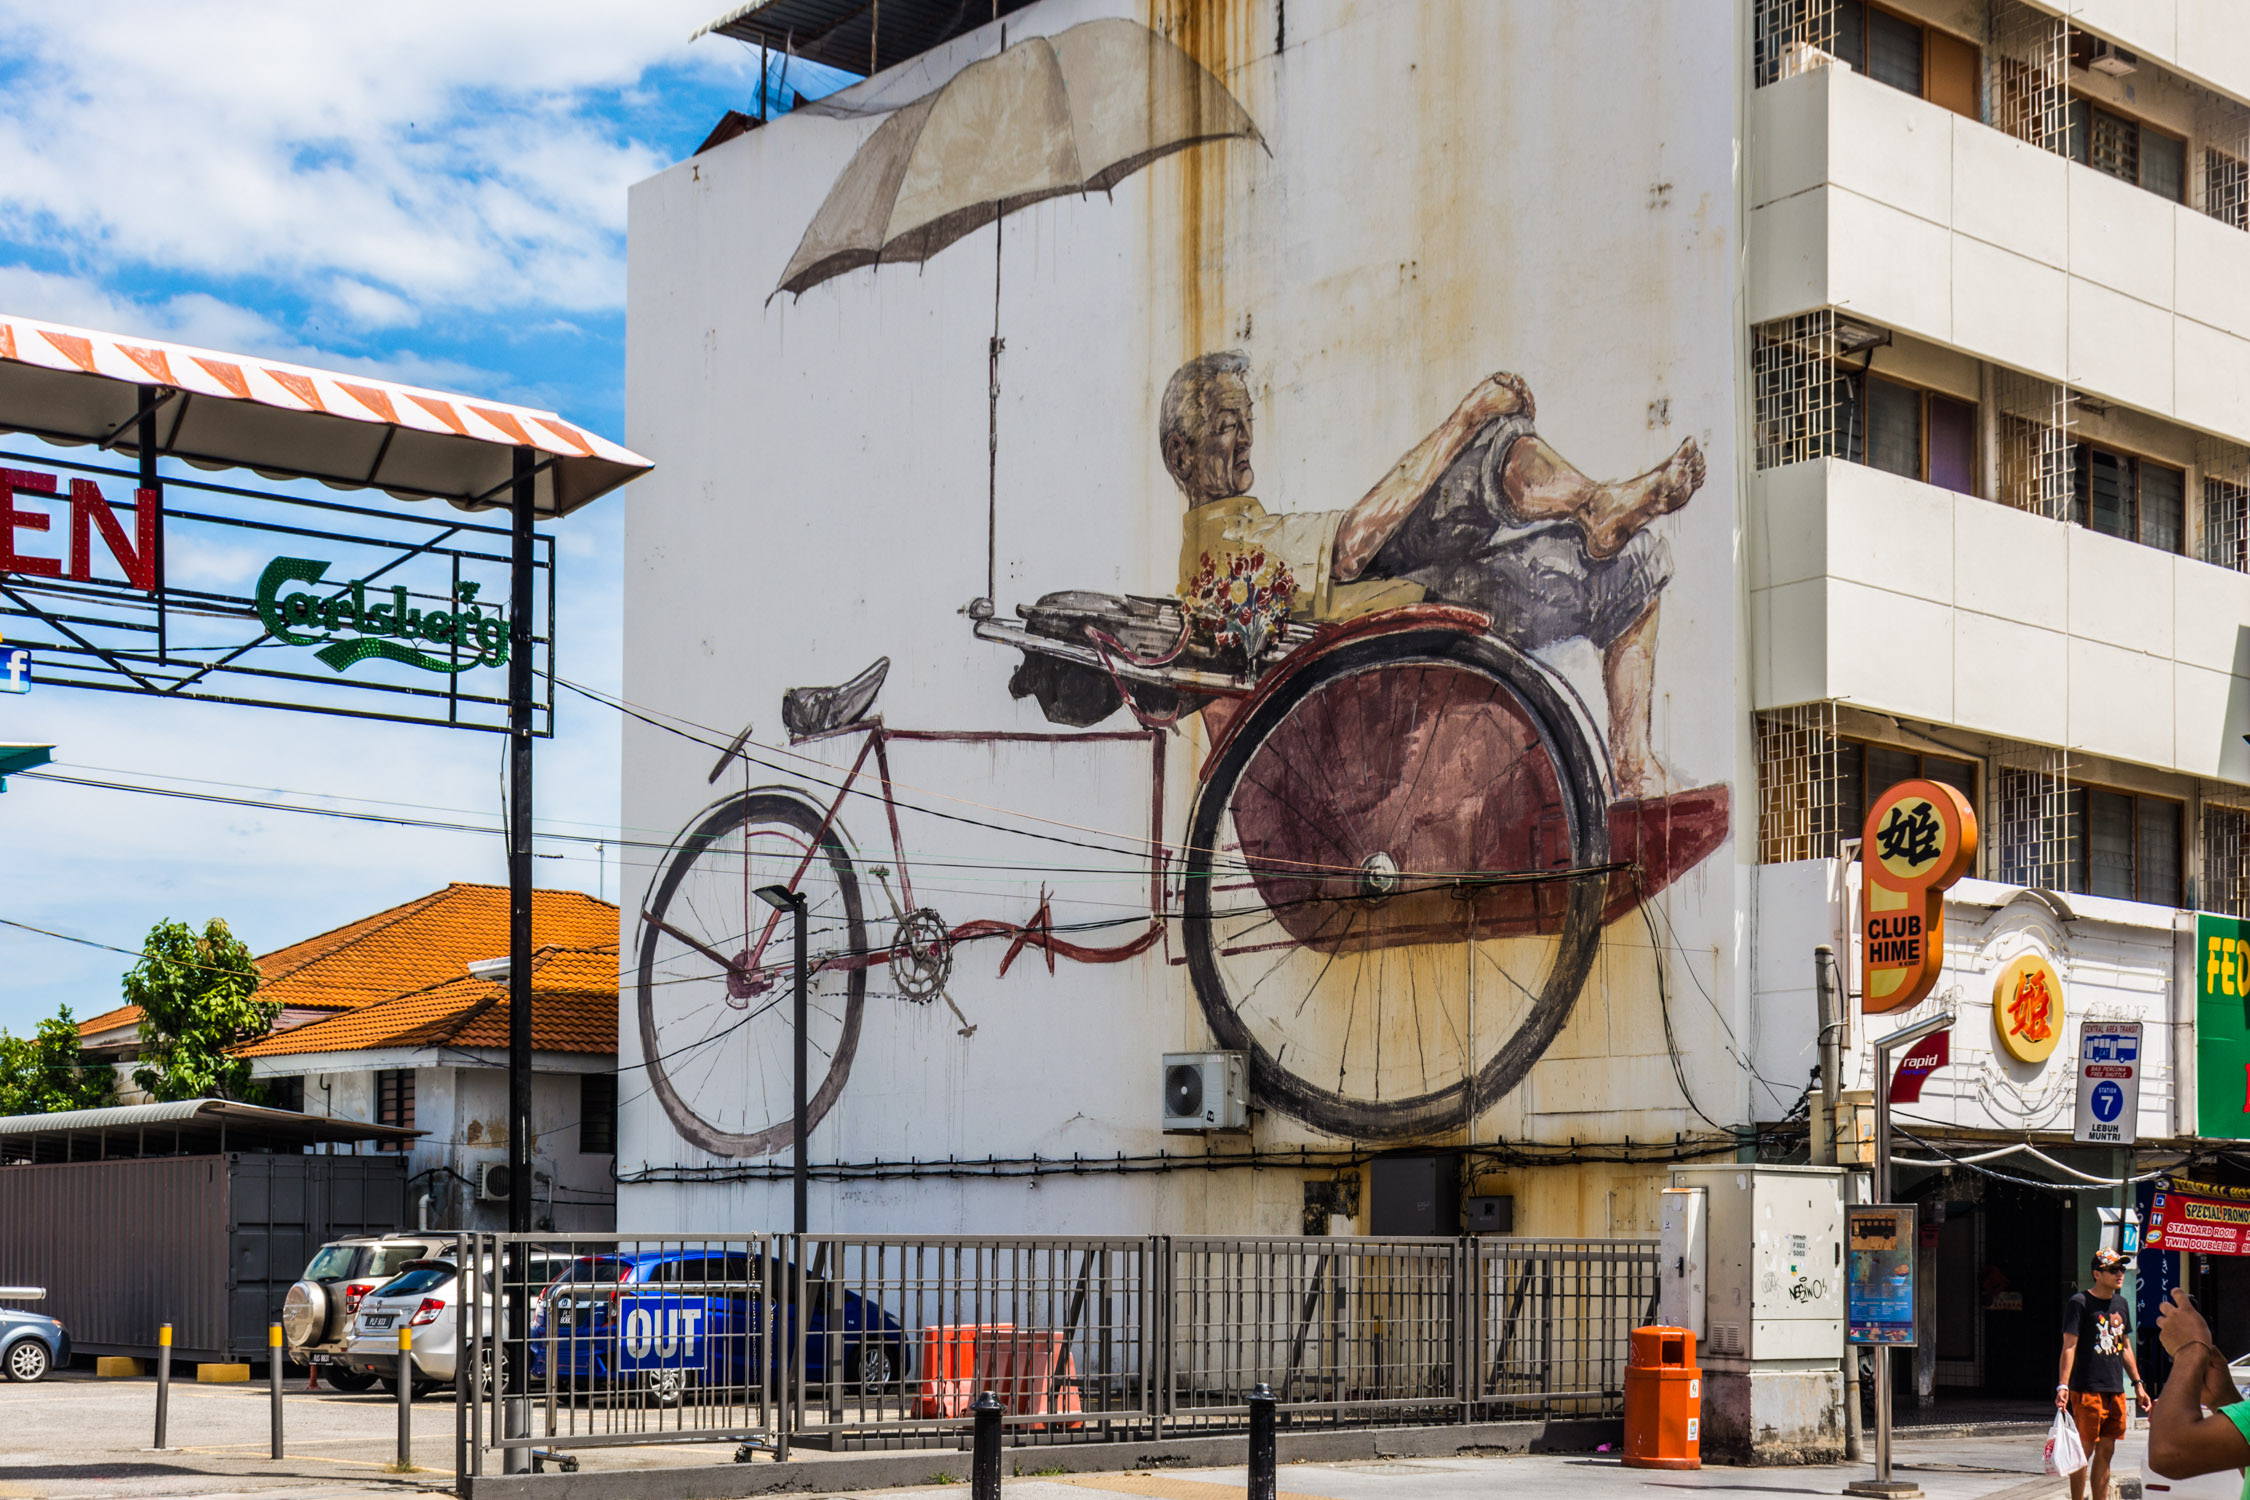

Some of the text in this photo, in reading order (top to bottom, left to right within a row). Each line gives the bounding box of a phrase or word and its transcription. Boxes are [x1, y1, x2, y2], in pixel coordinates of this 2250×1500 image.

[0, 467, 157, 591] EN
[256, 556, 512, 673] Carlsberg
[1868, 915, 1921, 940] CLUB
[1869, 939, 1920, 963] HIME
[2085, 1025, 2138, 1034] CENTRAL AREA TRANSIT
[1903, 1054, 1938, 1069] rapid
[2101, 1095, 2114, 1115] 7
[2088, 1132, 2121, 1141] MUNTRI
[2092, 1124, 2119, 1133] LEBUH
[2185, 1203, 2250, 1223] SPECIAL PROMO
[2167, 1222, 2213, 1236] STANDARD
[2213, 1227, 2237, 1238] ROOM
[2165, 1236, 2189, 1248] TWIN
[2190, 1238, 2221, 1250] DOUBLE
[2222, 1241, 2237, 1252] BED
[627, 1308, 702, 1359] OUT
